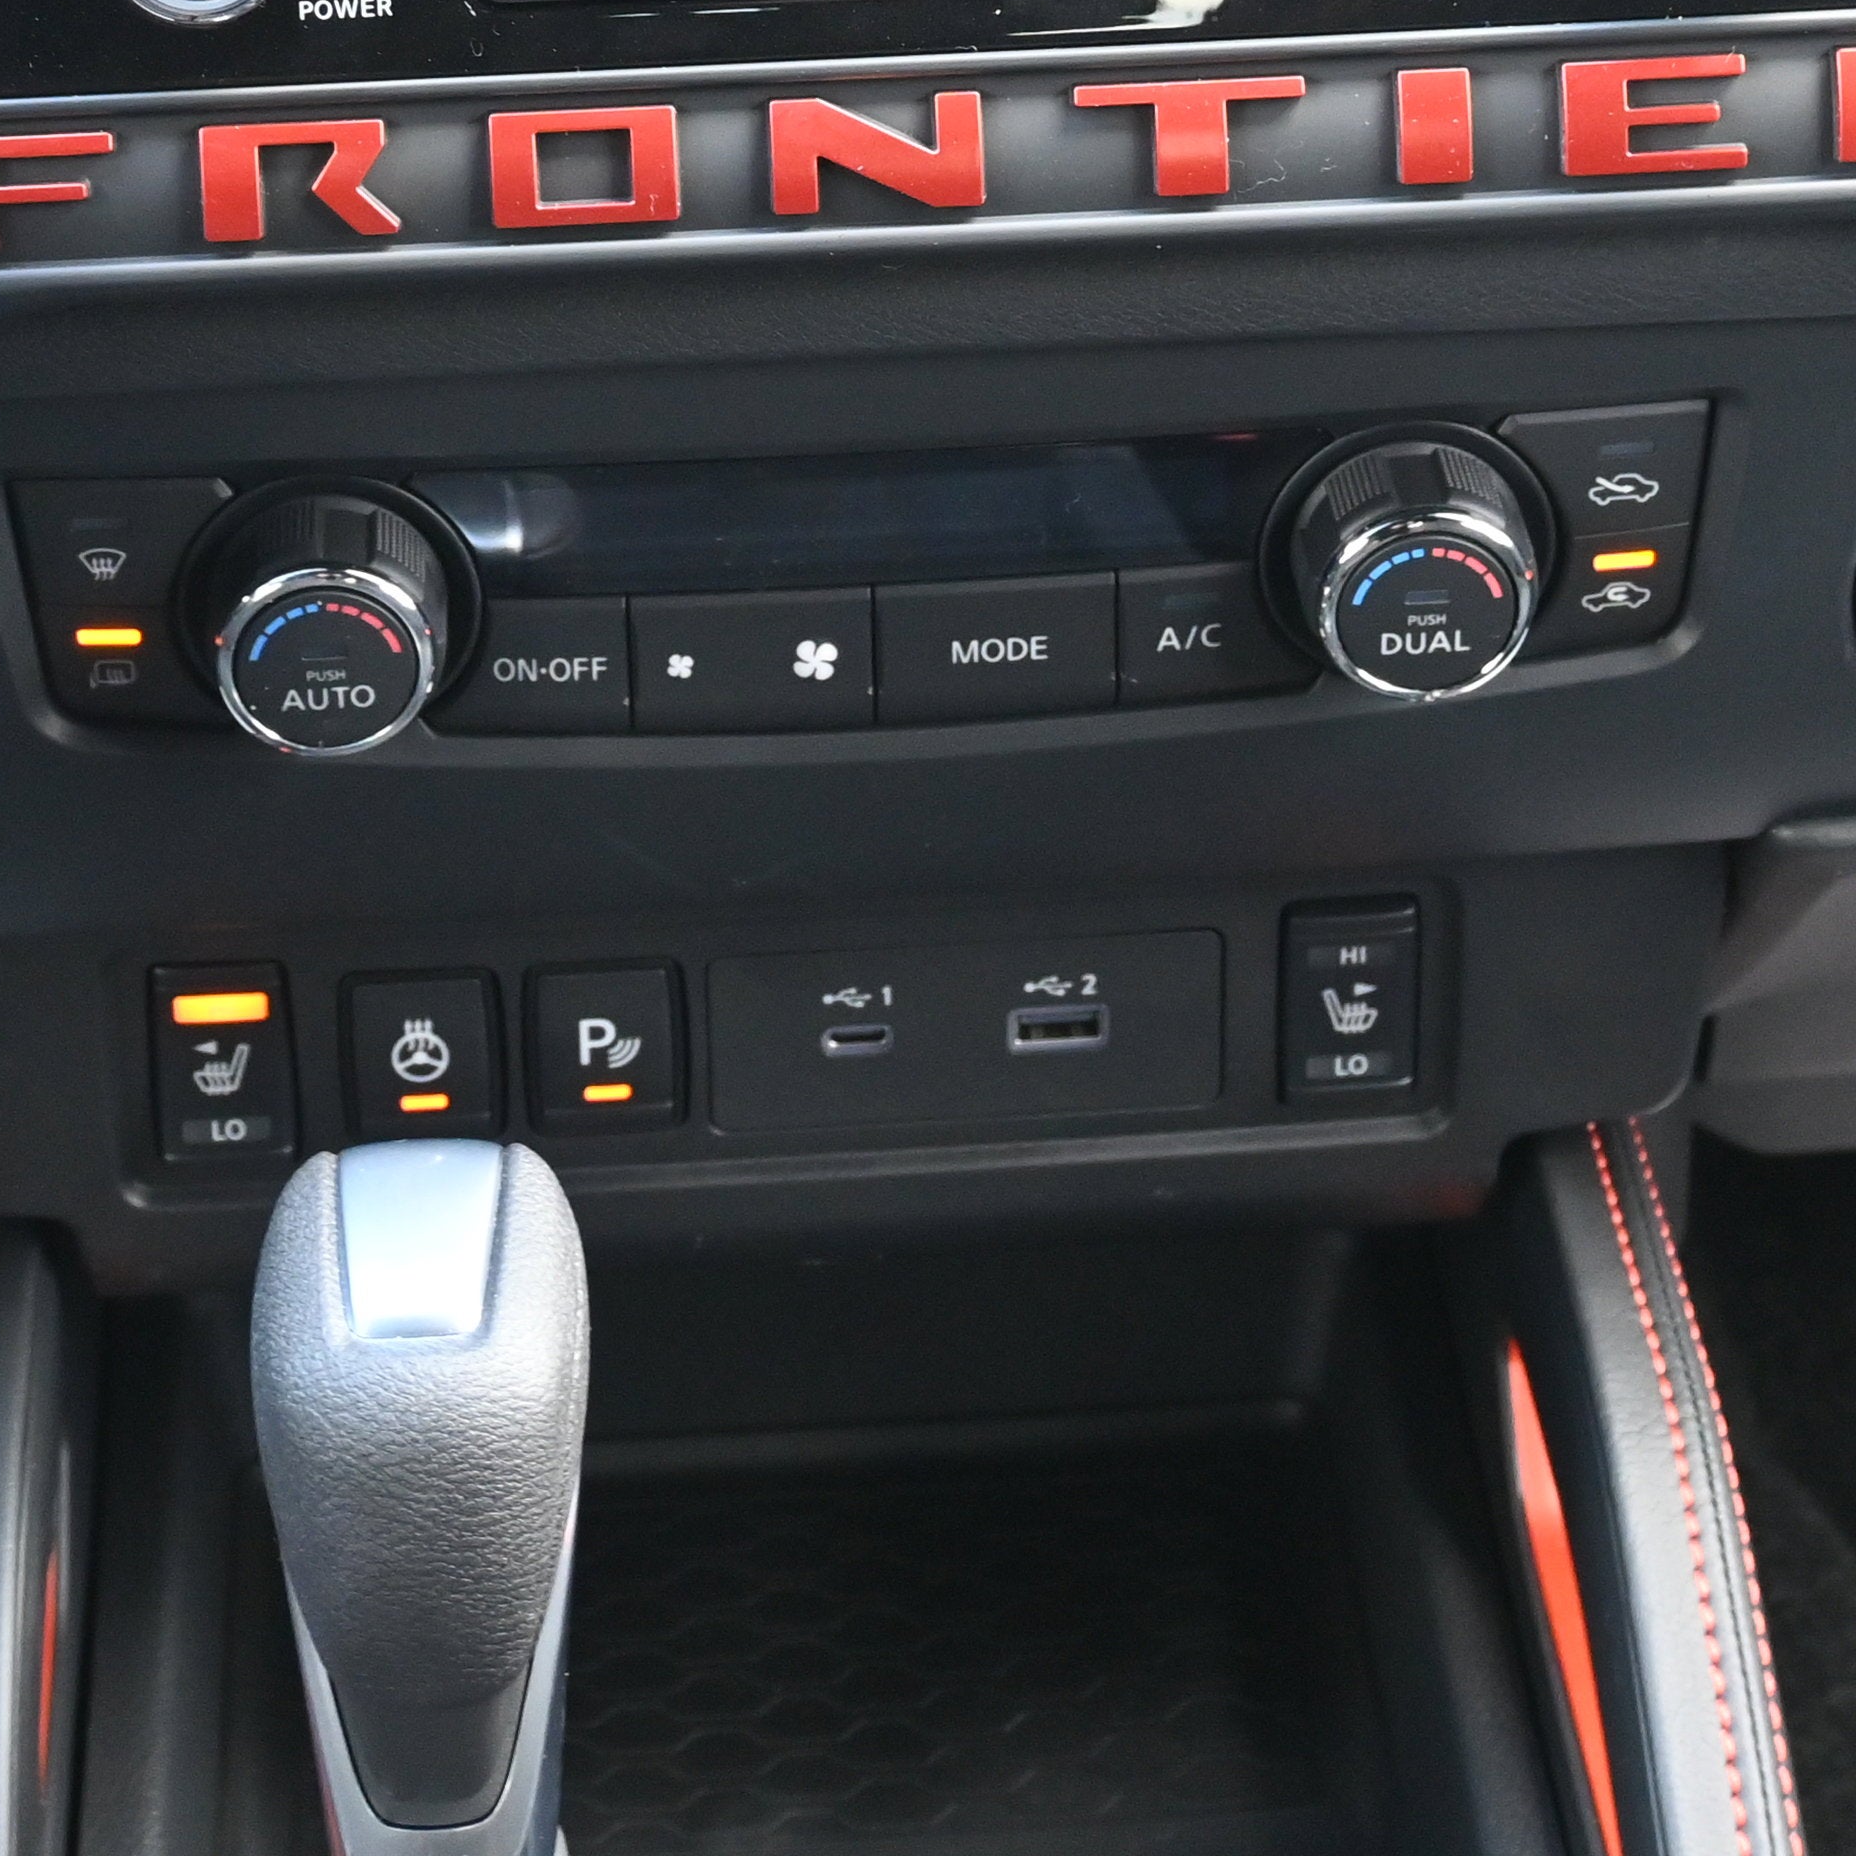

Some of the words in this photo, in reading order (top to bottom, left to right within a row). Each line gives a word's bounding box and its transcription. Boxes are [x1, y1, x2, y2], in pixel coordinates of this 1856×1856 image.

[1407, 613, 1447, 627] PUSH
[951, 635, 1048, 664] MODE
[1156, 624, 1219, 652] A/C
[1380, 629, 1471, 656] DUAL
[305, 669, 347, 682] PUSH
[282, 684, 376, 711] AUTO
[1340, 946, 1367, 965] HI
[882, 986, 892, 1006] 1
[1081, 973, 1097, 996] 2
[578, 1018, 609, 1066] P
[1334, 1054, 1369, 1077] LO
[211, 1118, 247, 1142] LO
